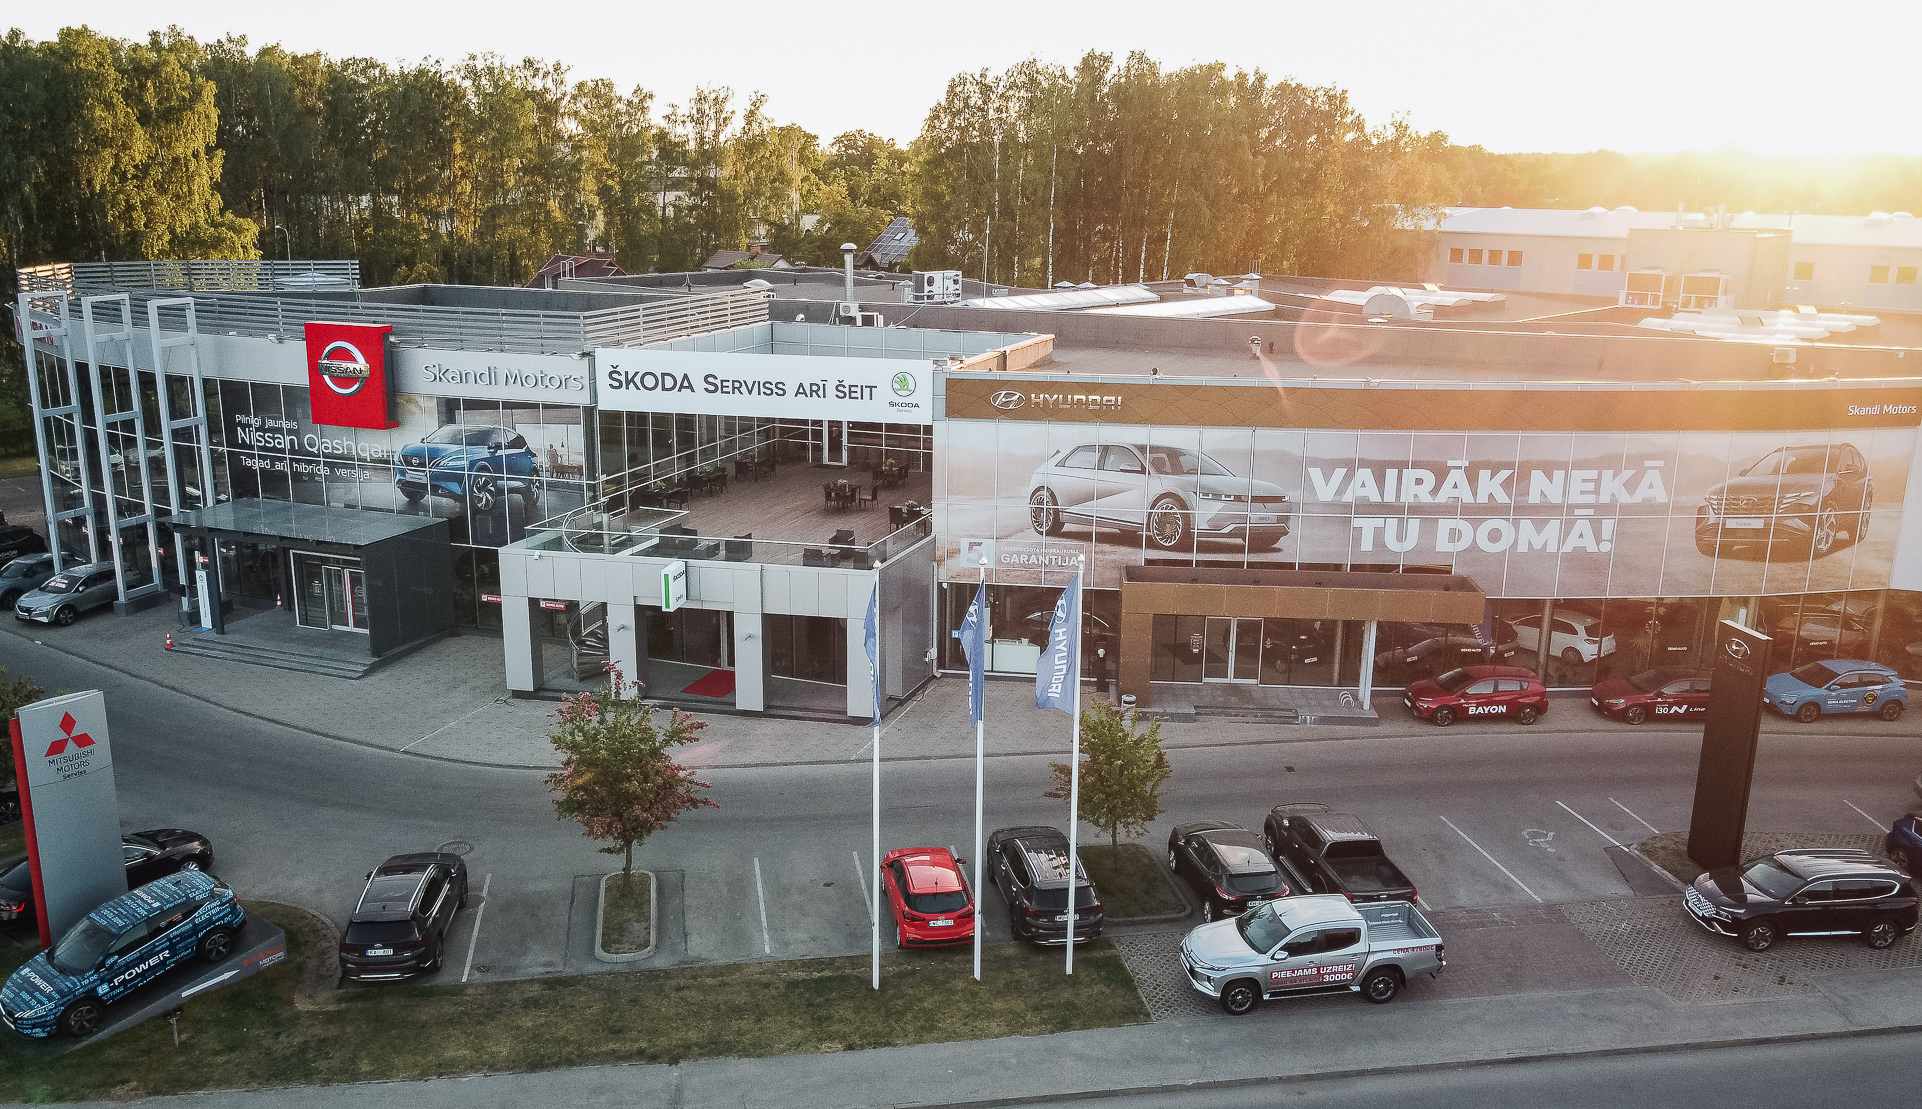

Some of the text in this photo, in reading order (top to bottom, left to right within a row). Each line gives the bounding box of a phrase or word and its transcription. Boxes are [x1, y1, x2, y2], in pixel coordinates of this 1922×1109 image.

[321, 363, 363, 375] NISSAN
[422, 363, 584, 391] Skandi Motors
[607, 364, 696, 393] ŠKODA
[834, 378, 878, 401] ŠEIT
[888, 400, 920, 409] ŠKODA
[1030, 393, 1122, 410] HYUNDAI
[1847, 403, 1917, 416] Skandi Motors
[264, 416, 298, 430] jaunais
[236, 426, 388, 462] Nissan Qashqai
[240, 455, 271, 470] Tagad
[334, 466, 370, 480] versija
[1307, 460, 1669, 504] VAIRĀK NEKĀ
[1353, 508, 1616, 553] TU DOMĀ!
[1000, 553, 1080, 567] GARANTIJA
[1047, 627, 1068, 699] HYUNDAI
[1468, 704, 1507, 715] BAYON
[48, 748, 95, 767] MITSUBISHI
[56, 759, 90, 774] MOTORS
[1271, 963, 1356, 979] PIEEJAMS UZREIZ!
